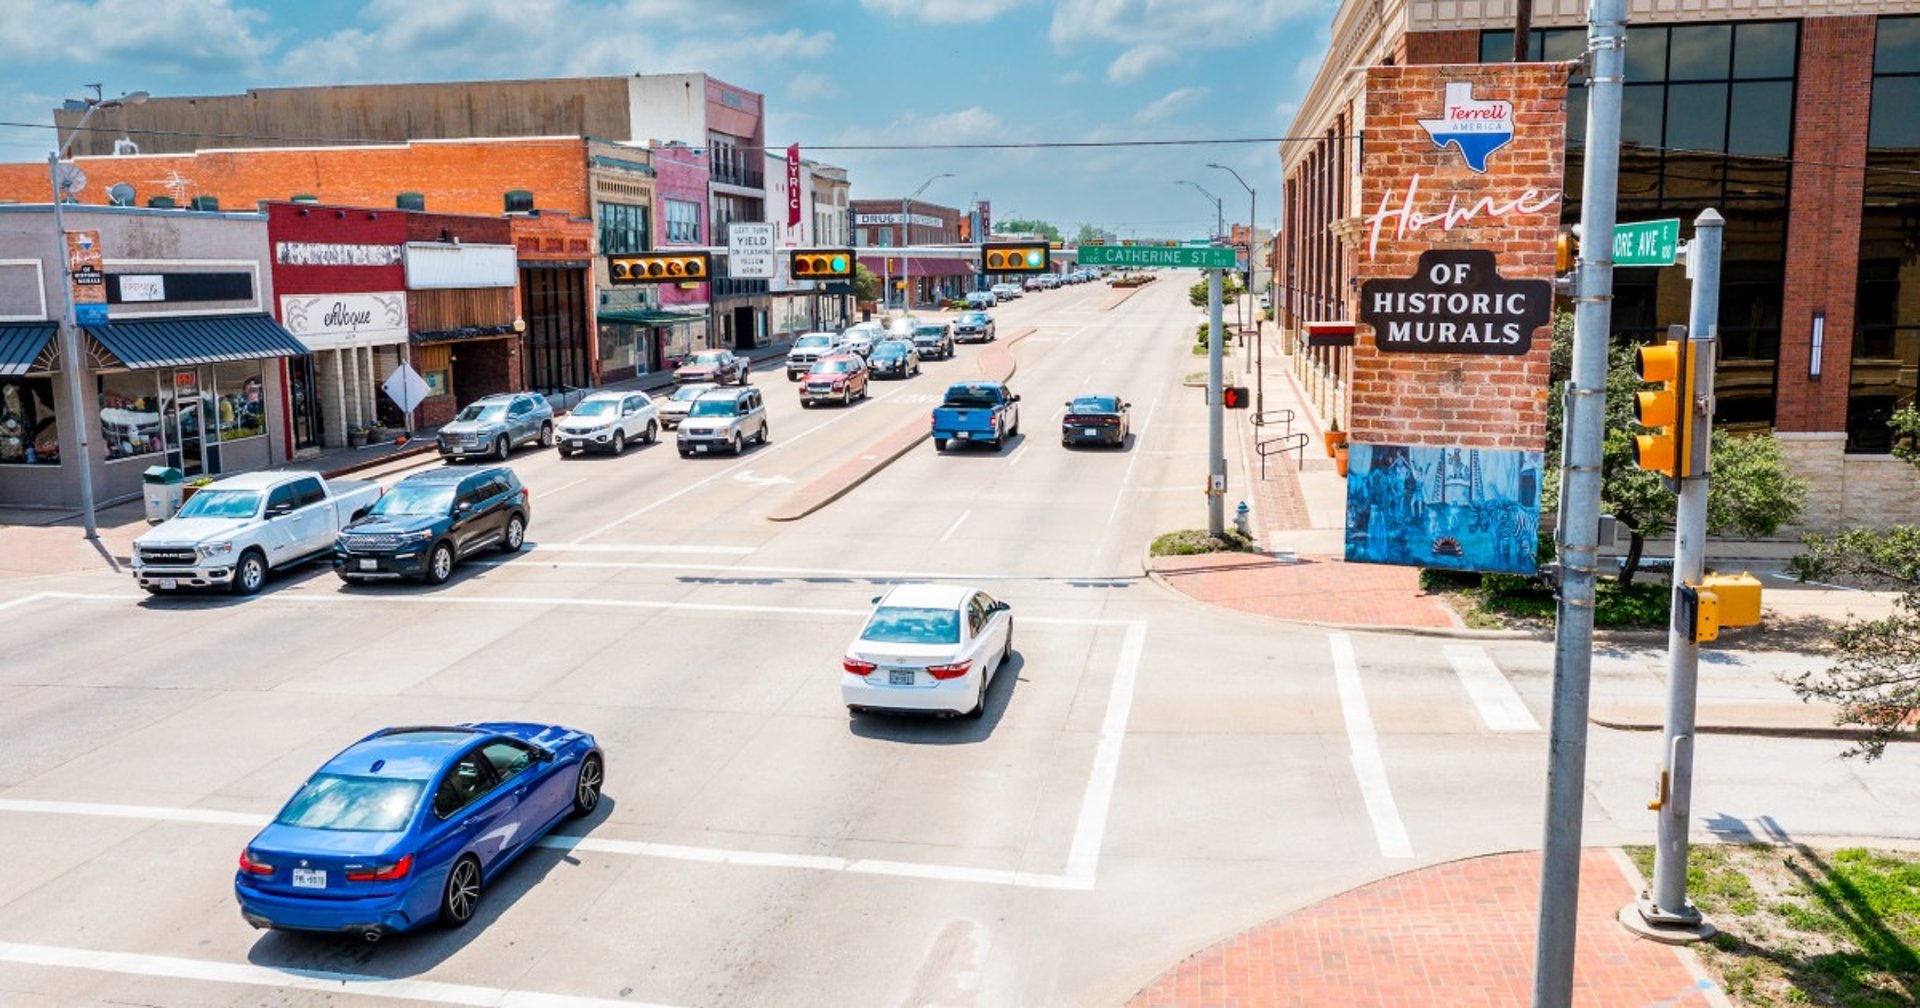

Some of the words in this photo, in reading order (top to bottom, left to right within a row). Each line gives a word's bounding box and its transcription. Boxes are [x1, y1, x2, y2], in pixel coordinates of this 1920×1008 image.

[1450, 104, 1507, 121] Terrell
[1451, 122, 1502, 131] AMERICA
[789, 156, 798, 208] LYRIC
[861, 215, 894, 223] DRUG
[1364, 173, 1560, 261] Home
[734, 226, 749, 234] LEFT
[752, 226, 769, 234] TURN
[1663, 225, 1669, 240] E
[737, 236, 767, 246] YIELD
[1638, 230, 1658, 256] AVE
[1105, 249, 1181, 263] CATHERINE
[1191, 251, 1207, 263] ST
[1430, 263, 1471, 285] OF
[1373, 292, 1526, 314] HISTORIC
[1388, 321, 1520, 344] MURALS
